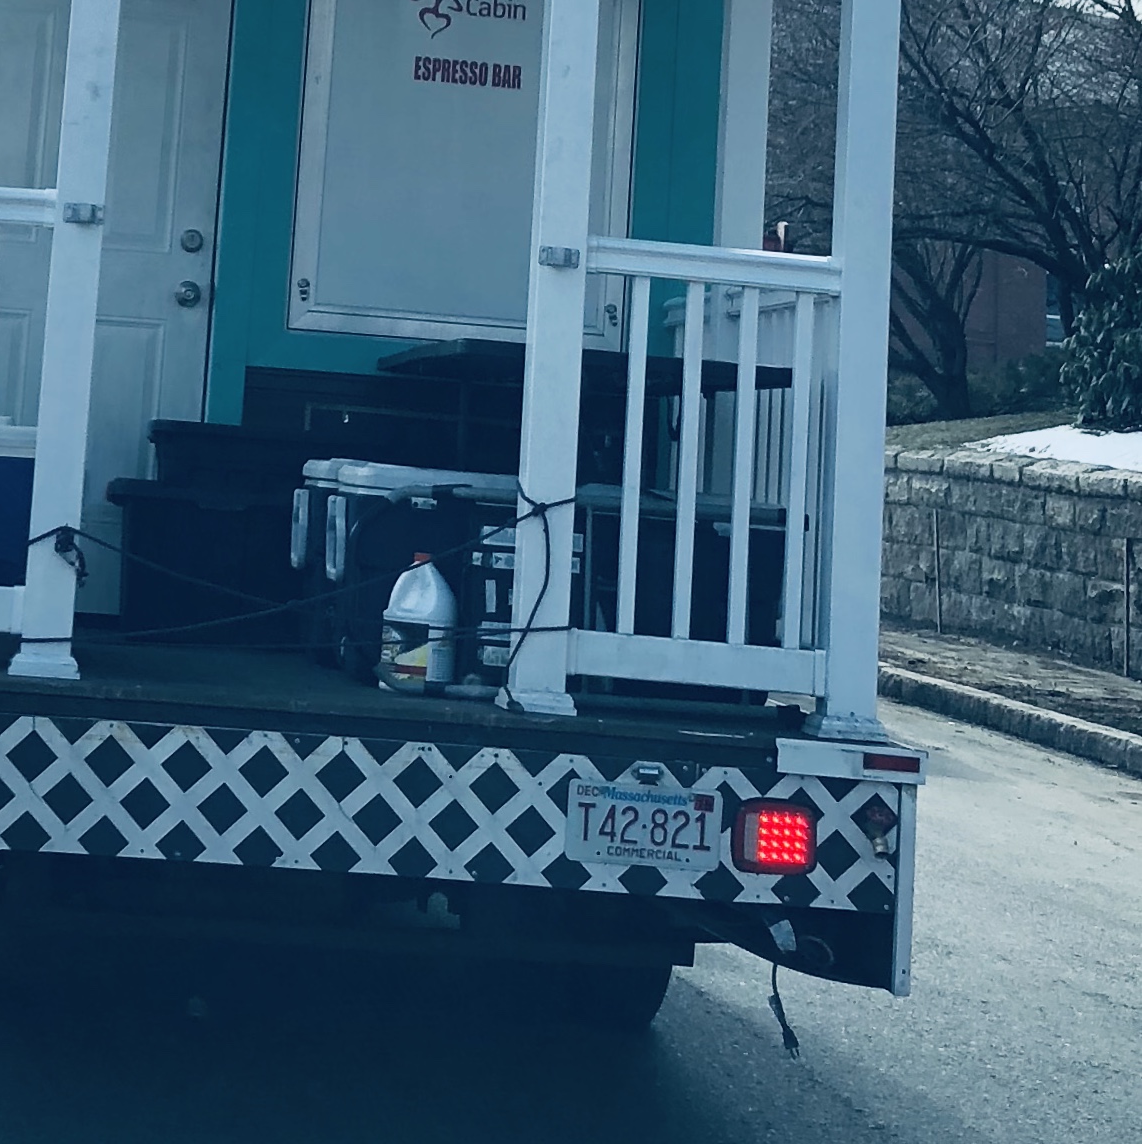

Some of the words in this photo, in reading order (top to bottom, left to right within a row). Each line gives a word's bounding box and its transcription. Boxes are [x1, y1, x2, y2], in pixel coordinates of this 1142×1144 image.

[413, 56, 489, 87] ESPRESSO
[491, 63, 522, 90] BAR
[577, 784, 599, 797] DEC
[605, 786, 688, 806] Massachusetts
[606, 845, 682, 862] COMMERCIAL
